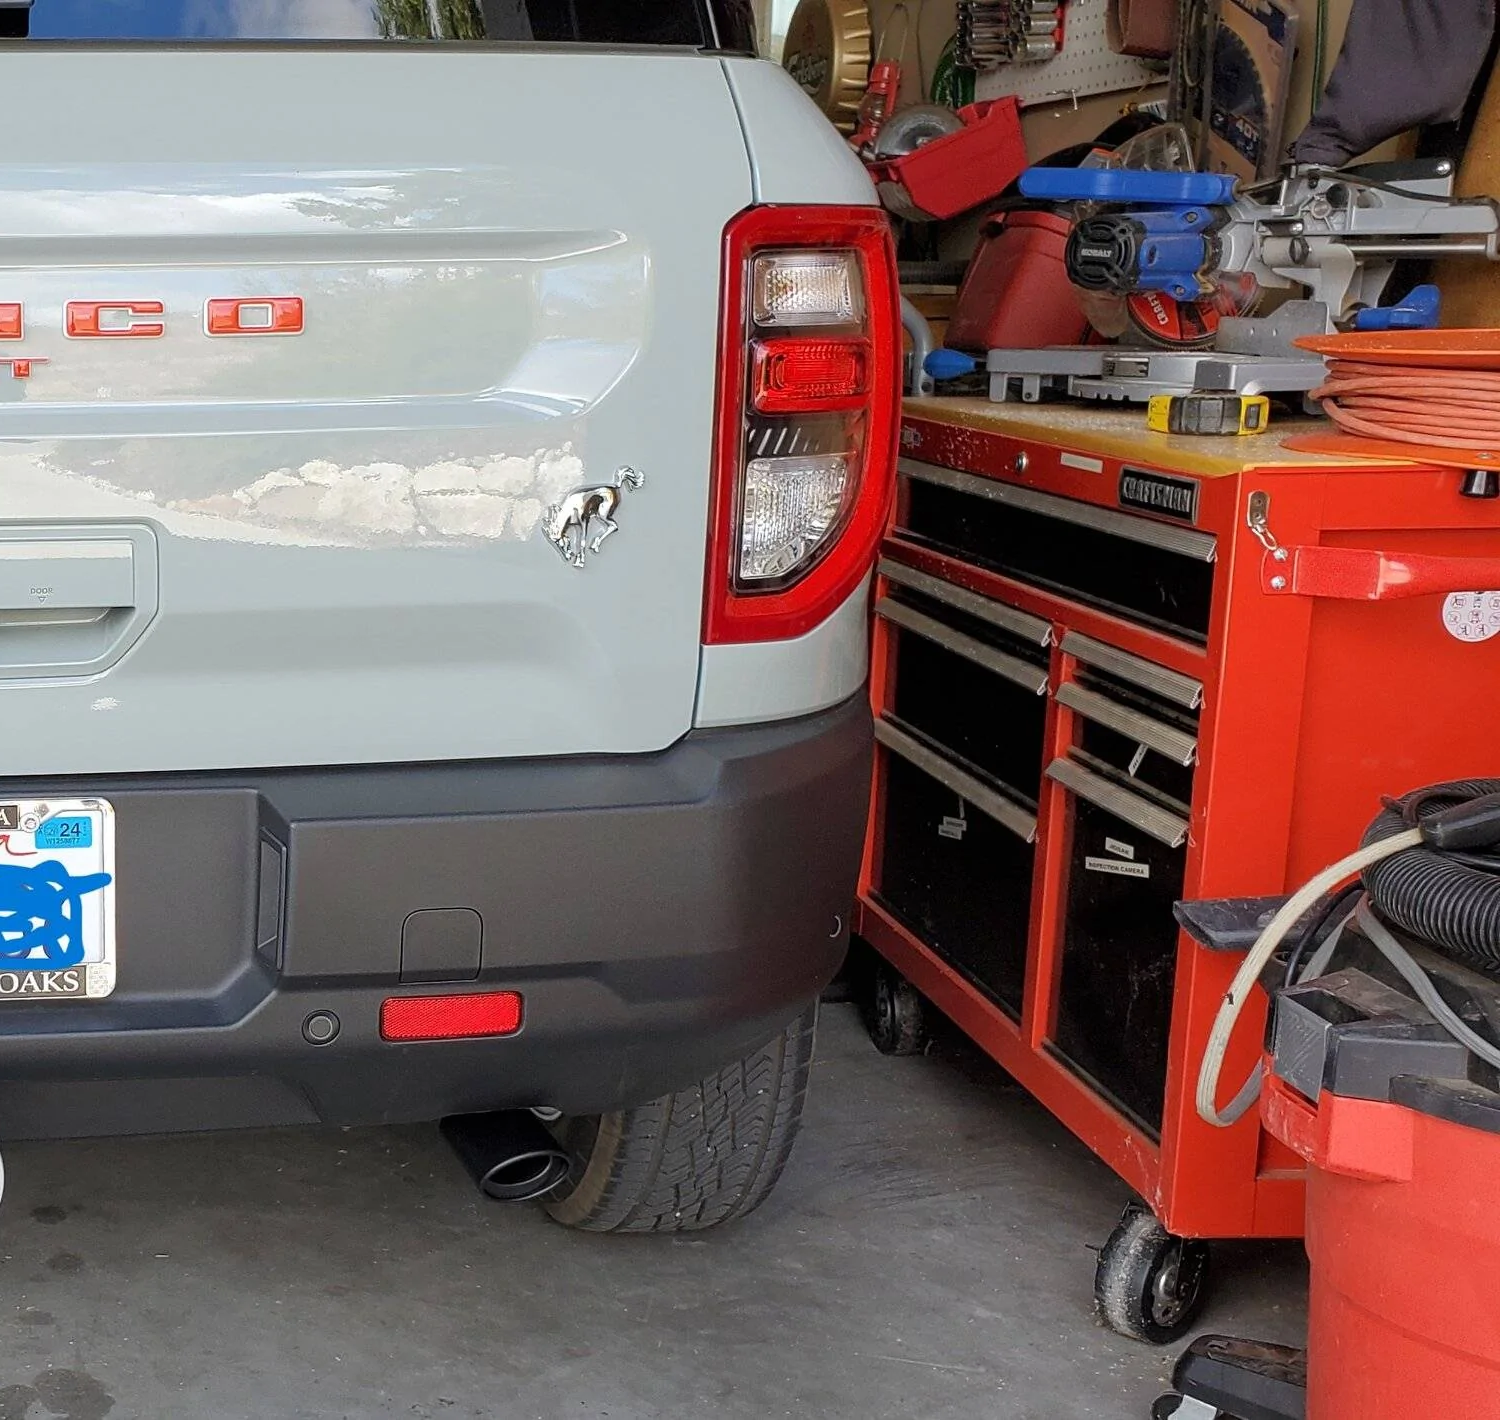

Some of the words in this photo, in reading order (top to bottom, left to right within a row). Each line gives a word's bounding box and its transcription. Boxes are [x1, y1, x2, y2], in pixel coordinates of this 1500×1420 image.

[1081, 248, 1112, 258] KOBALT
[1122, 476, 1192, 513] CRAFTSMAN
[30, 587, 54, 595] DOOR
[60, 822, 82, 838] 24
